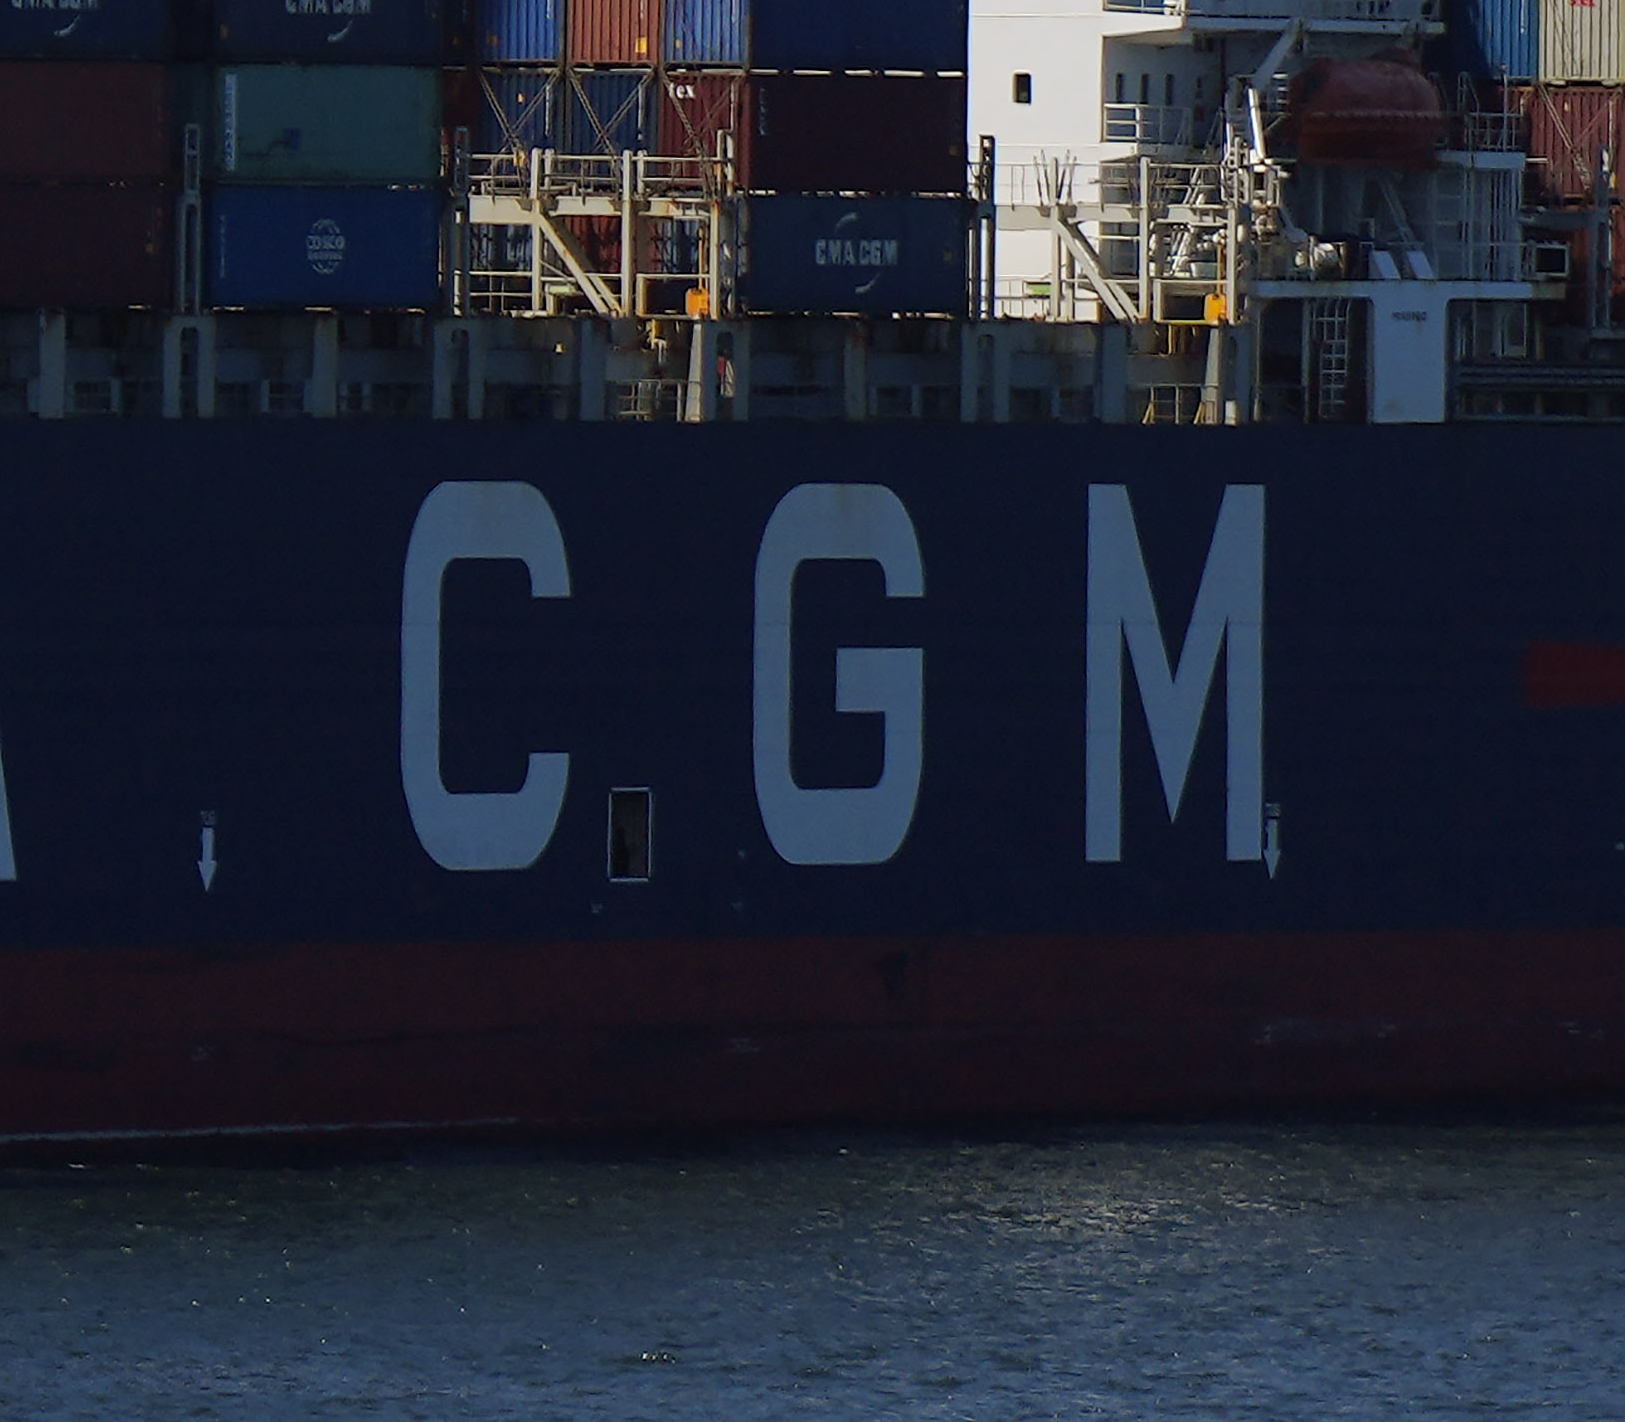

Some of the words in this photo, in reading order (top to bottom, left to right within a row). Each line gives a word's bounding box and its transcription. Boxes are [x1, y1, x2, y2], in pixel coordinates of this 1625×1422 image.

[815, 239, 855, 266] CMA
[858, 239, 898, 266] CGM
[400, 480, 1267, 871] CGM
